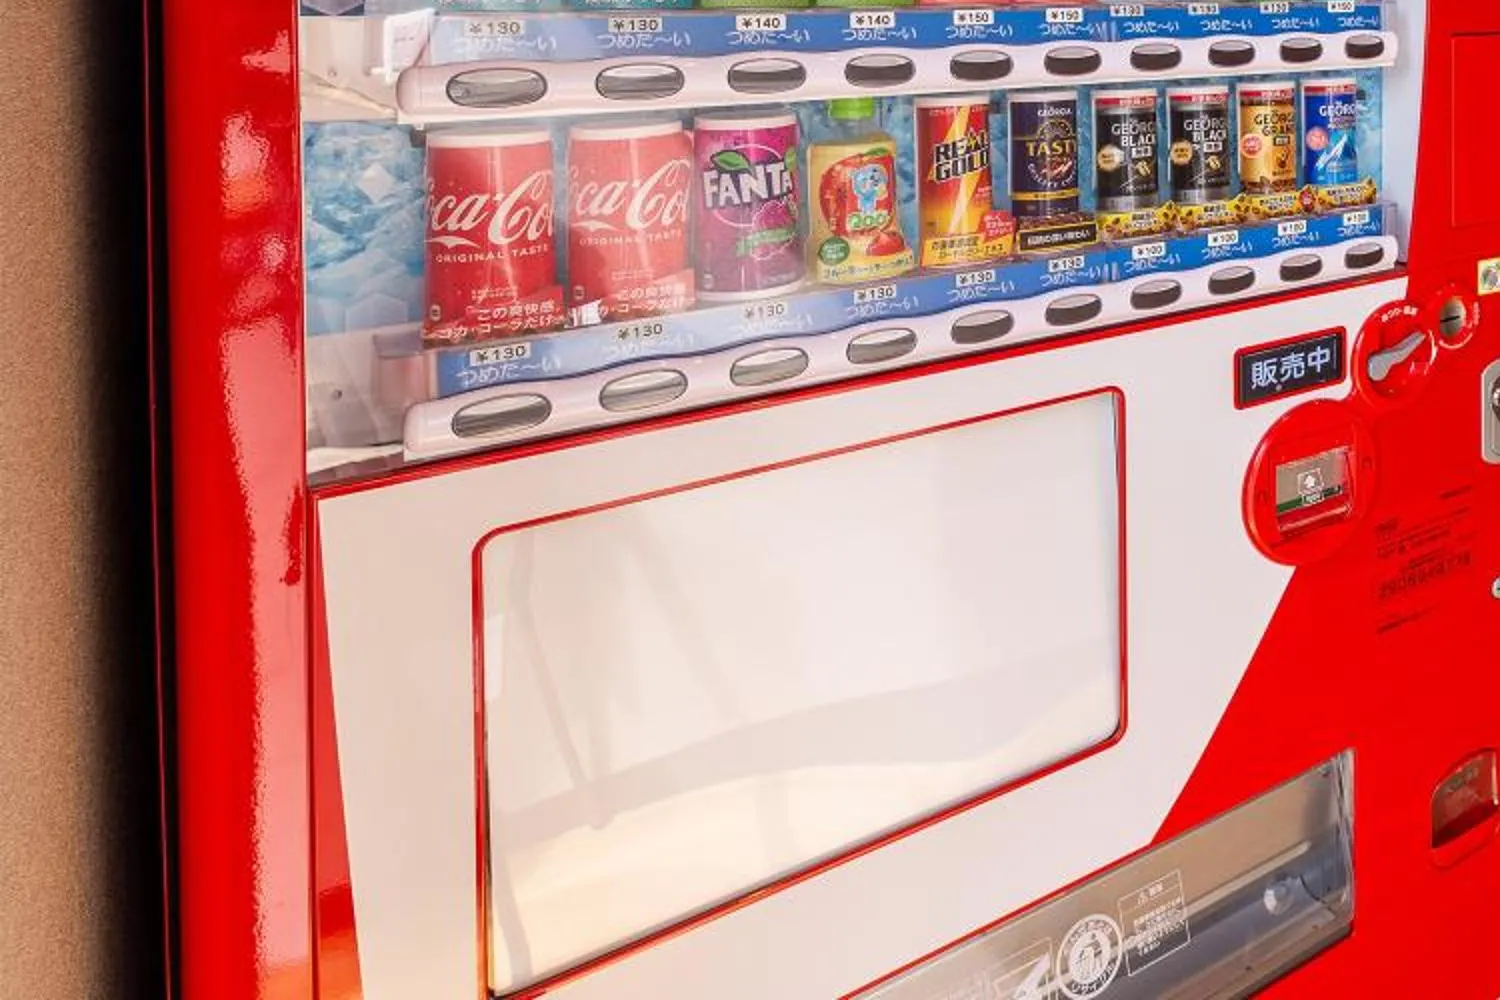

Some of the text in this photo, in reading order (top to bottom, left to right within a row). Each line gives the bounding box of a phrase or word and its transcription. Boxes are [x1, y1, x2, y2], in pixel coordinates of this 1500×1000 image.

[613, 19, 659, 32] ¥130
[741, 17, 781, 29] ¥140
[855, 15, 891, 26] ¥140
[1025, 139, 1077, 157] TAST
[703, 161, 793, 209] FANTA
[476, 345, 526, 362] ¥130
[1250, 346, 1333, 389] 販売中
